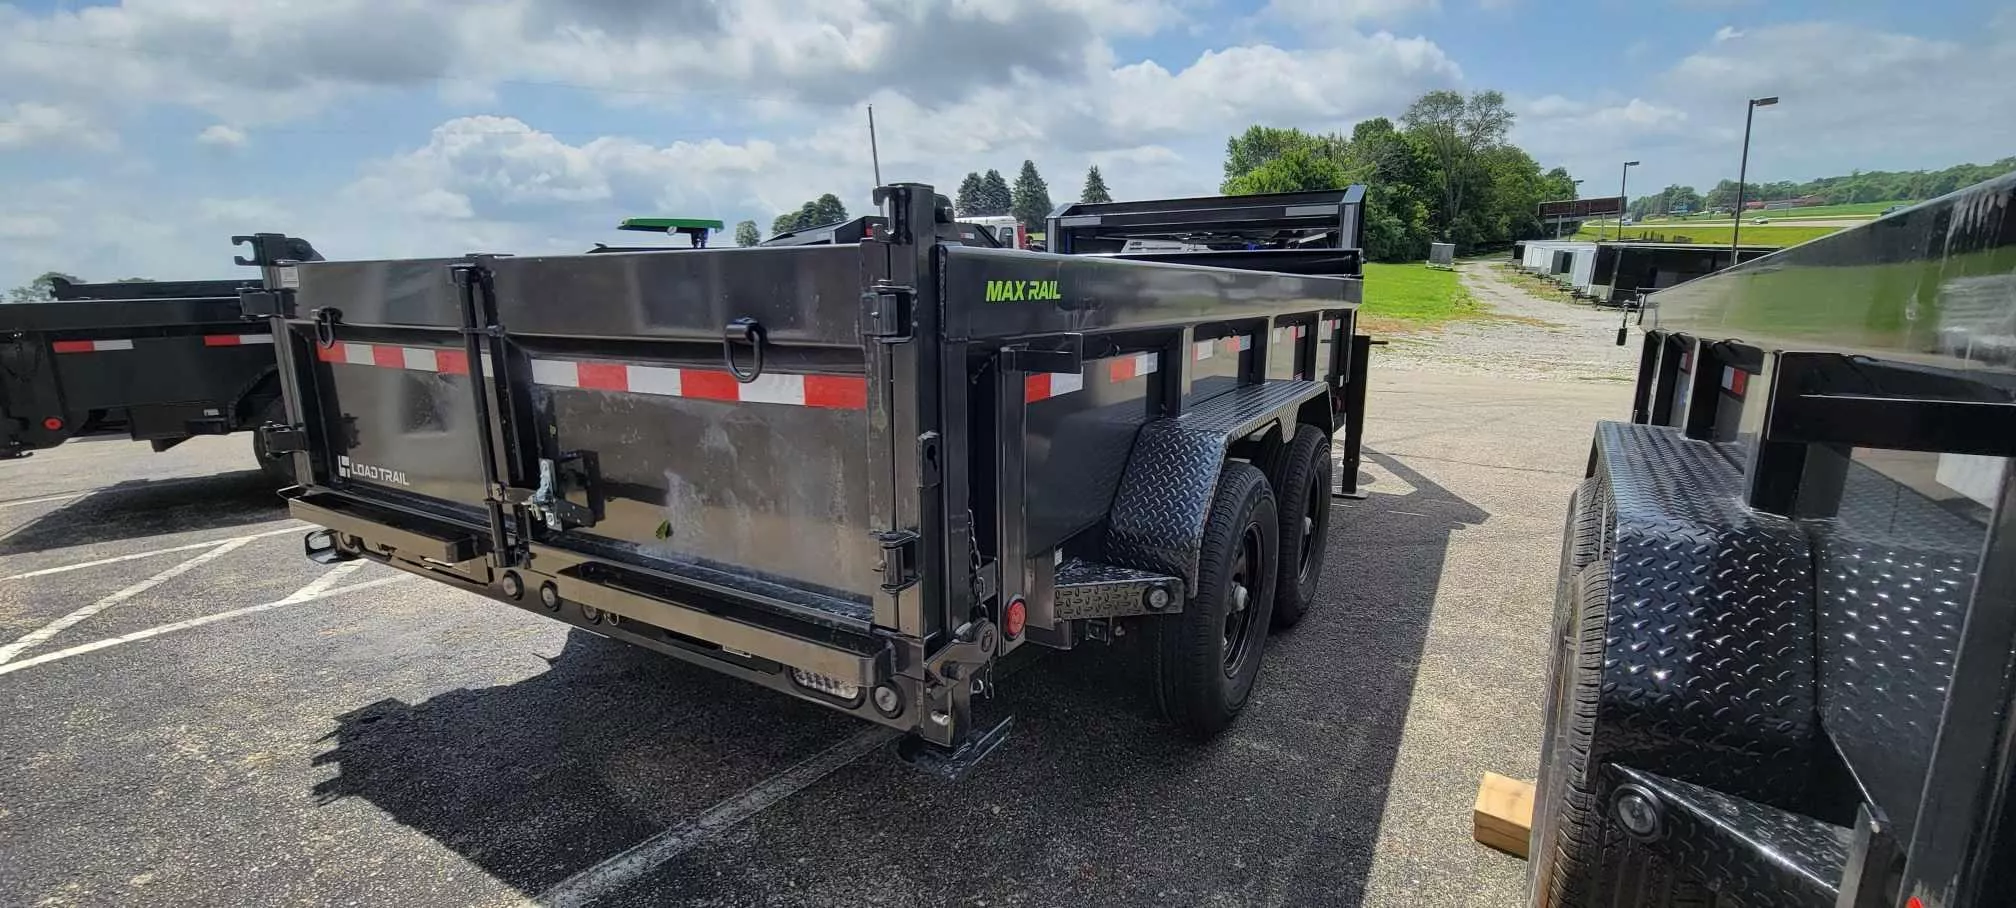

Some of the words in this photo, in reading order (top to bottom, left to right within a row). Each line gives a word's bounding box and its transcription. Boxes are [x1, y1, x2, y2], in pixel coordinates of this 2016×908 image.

[985, 280, 1026, 302] MAX
[1028, 280, 1061, 301] RAIL
[351, 462, 378, 479] LOAD
[379, 467, 410, 486] TRAIL
